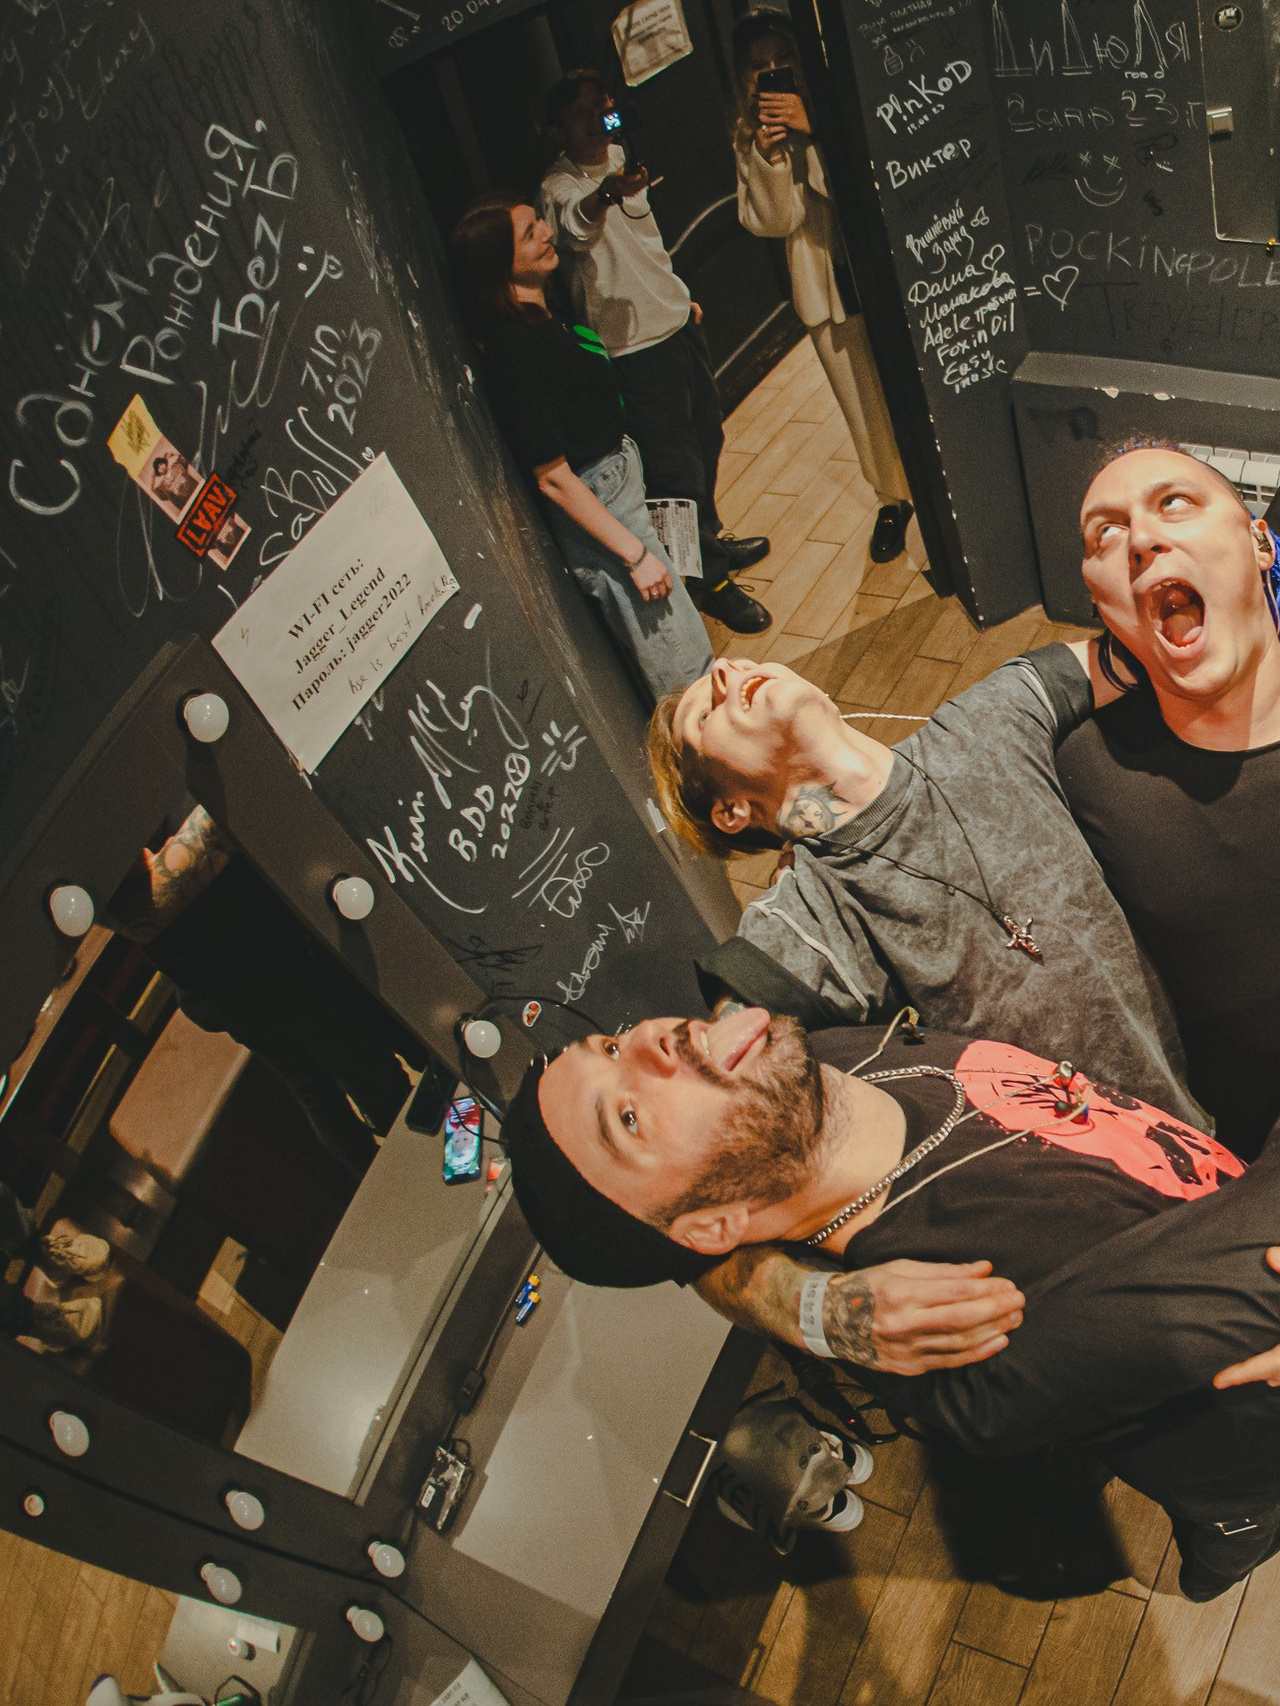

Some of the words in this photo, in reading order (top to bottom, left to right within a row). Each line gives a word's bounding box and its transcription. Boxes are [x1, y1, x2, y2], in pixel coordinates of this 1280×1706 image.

[886, 138, 971, 189] Виктор
[327, 320, 382, 433] 2023
[286, 593, 334, 642] WI-FI
[327, 556, 367, 598] сеть:
[289, 646, 350, 714] Пароль:
[341, 570, 414, 655] jagger2022
[290, 565, 387, 677] Jagger_Legend
